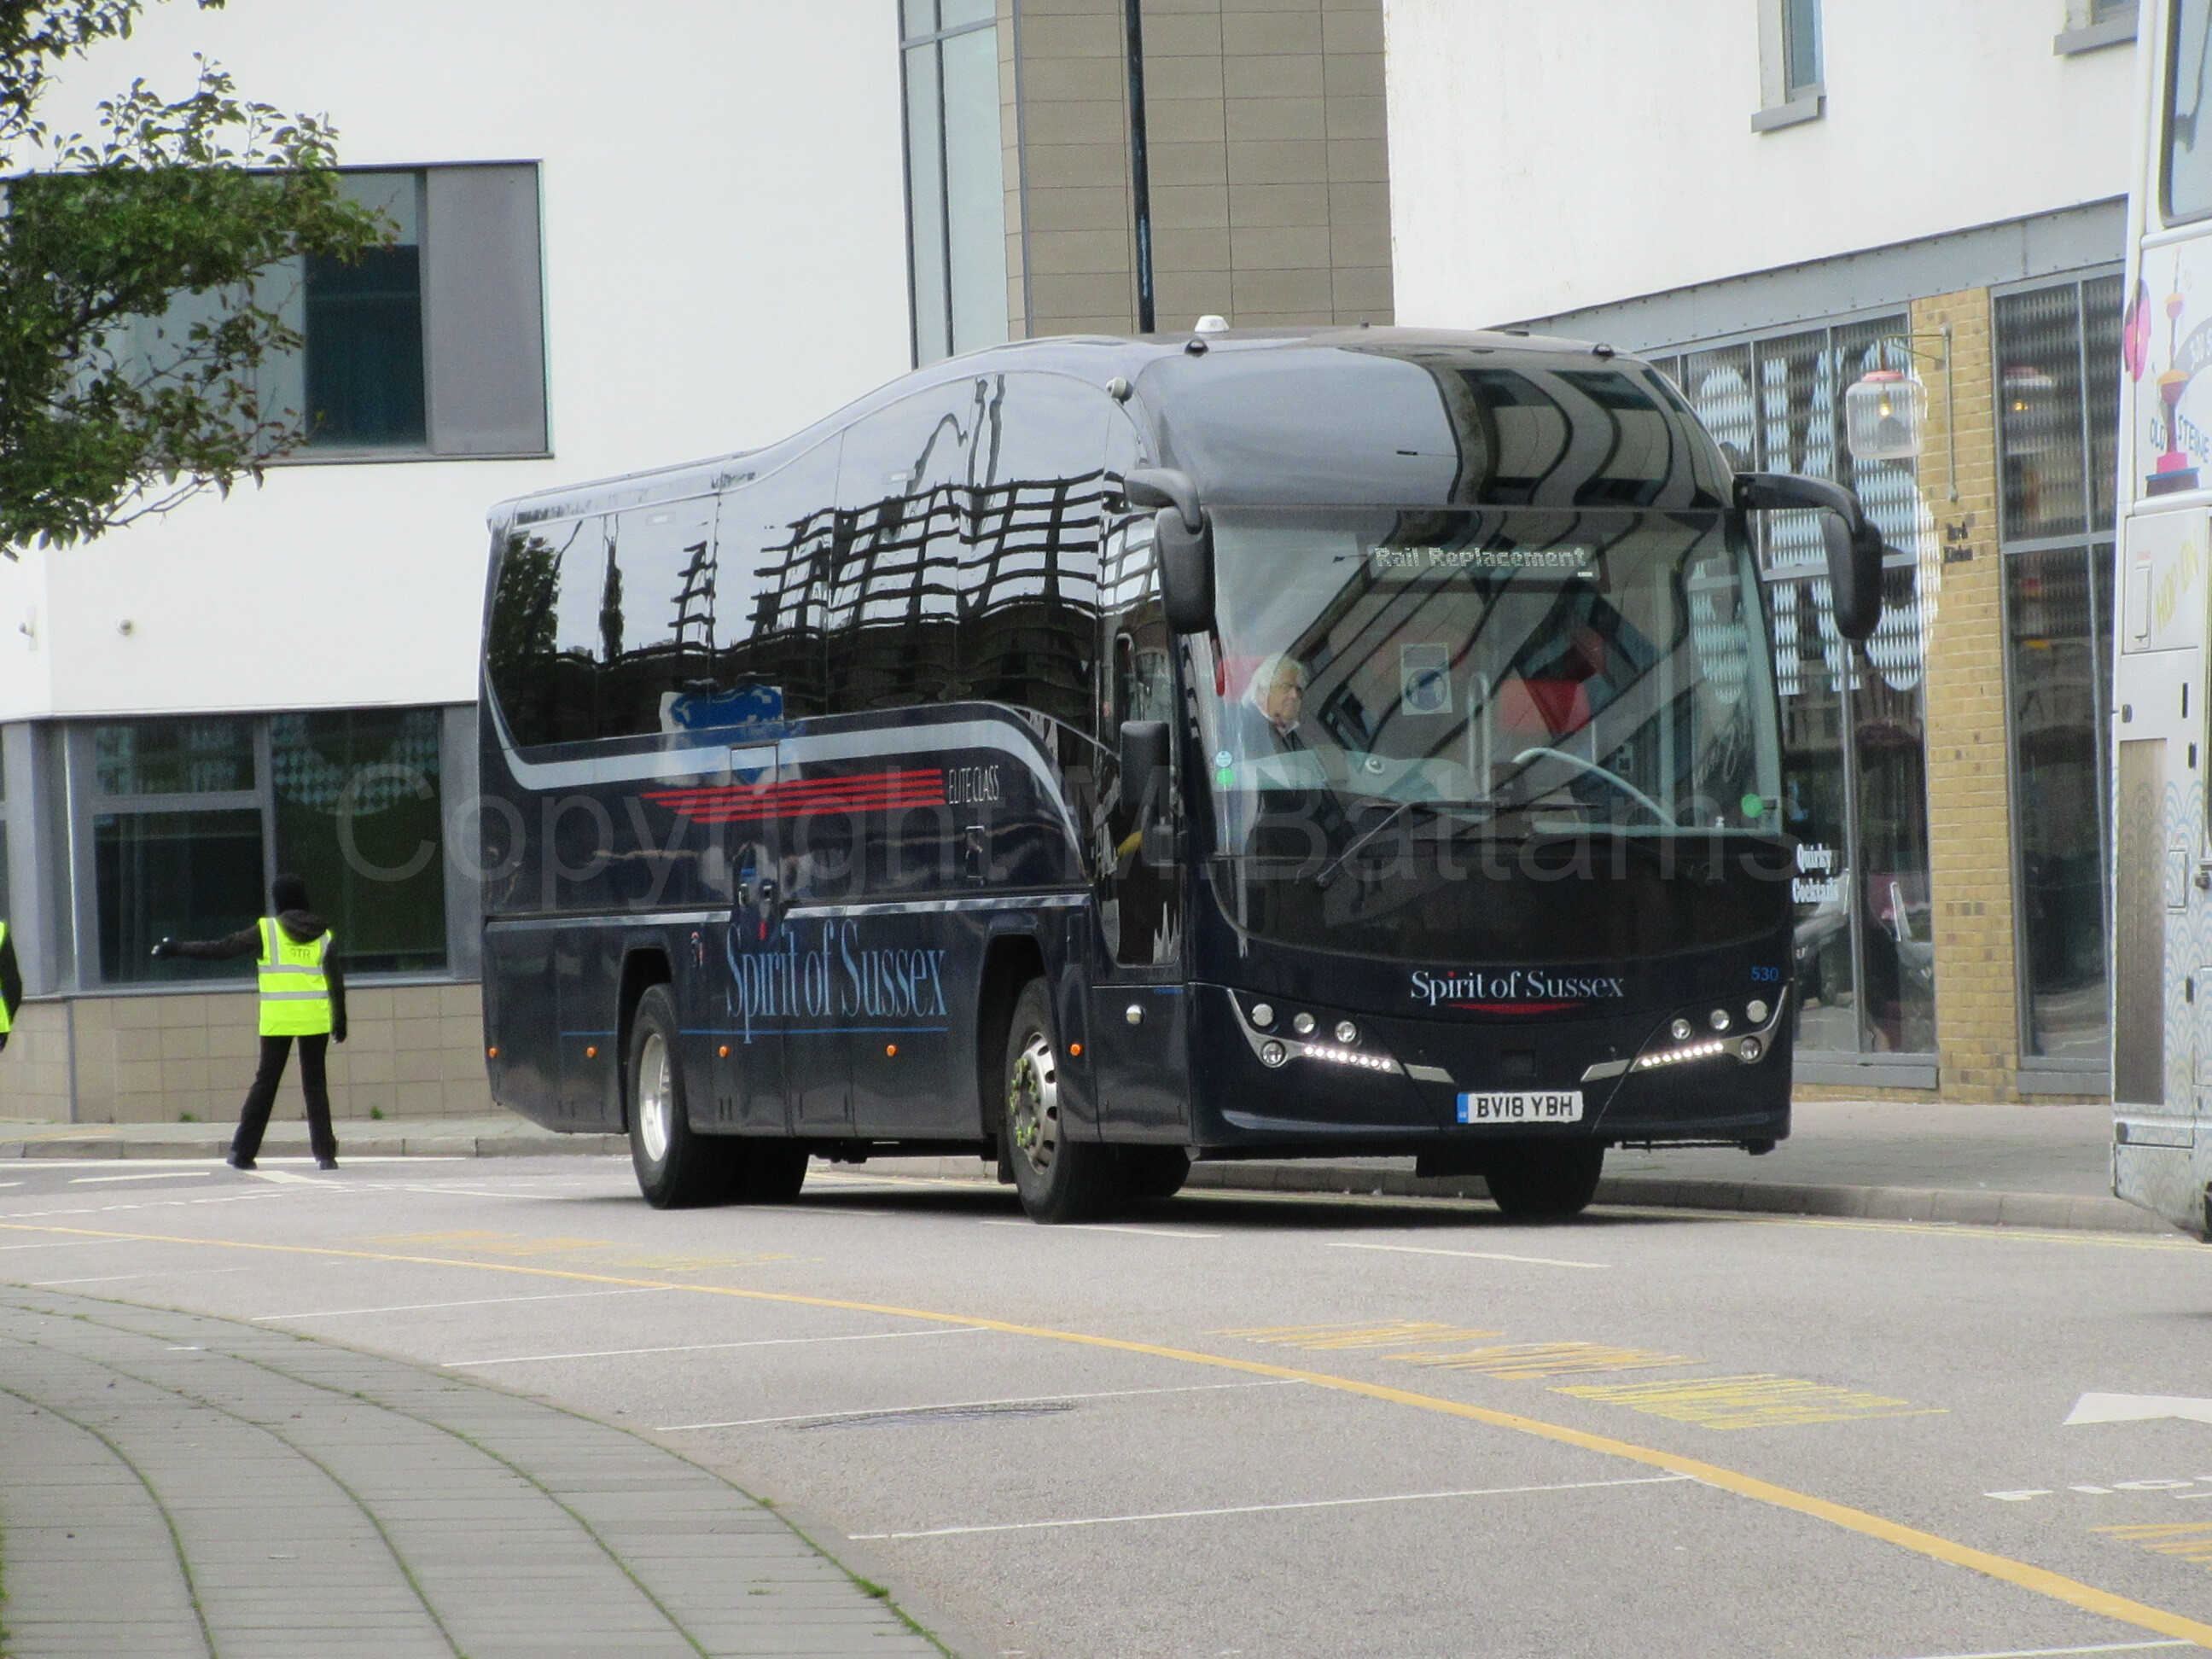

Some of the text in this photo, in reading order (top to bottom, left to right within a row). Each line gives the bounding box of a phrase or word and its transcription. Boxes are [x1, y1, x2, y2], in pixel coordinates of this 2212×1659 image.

[1374, 546, 1586, 568] Rail Replacement
[1796, 843, 1832, 875] Quirky
[726, 920, 947, 1044] Spirit of Sussex
[1751, 966, 1779, 981] 530
[1410, 970, 1625, 1006] Spirit of Sussex
[1476, 1096, 1574, 1118] BV18 YBH
